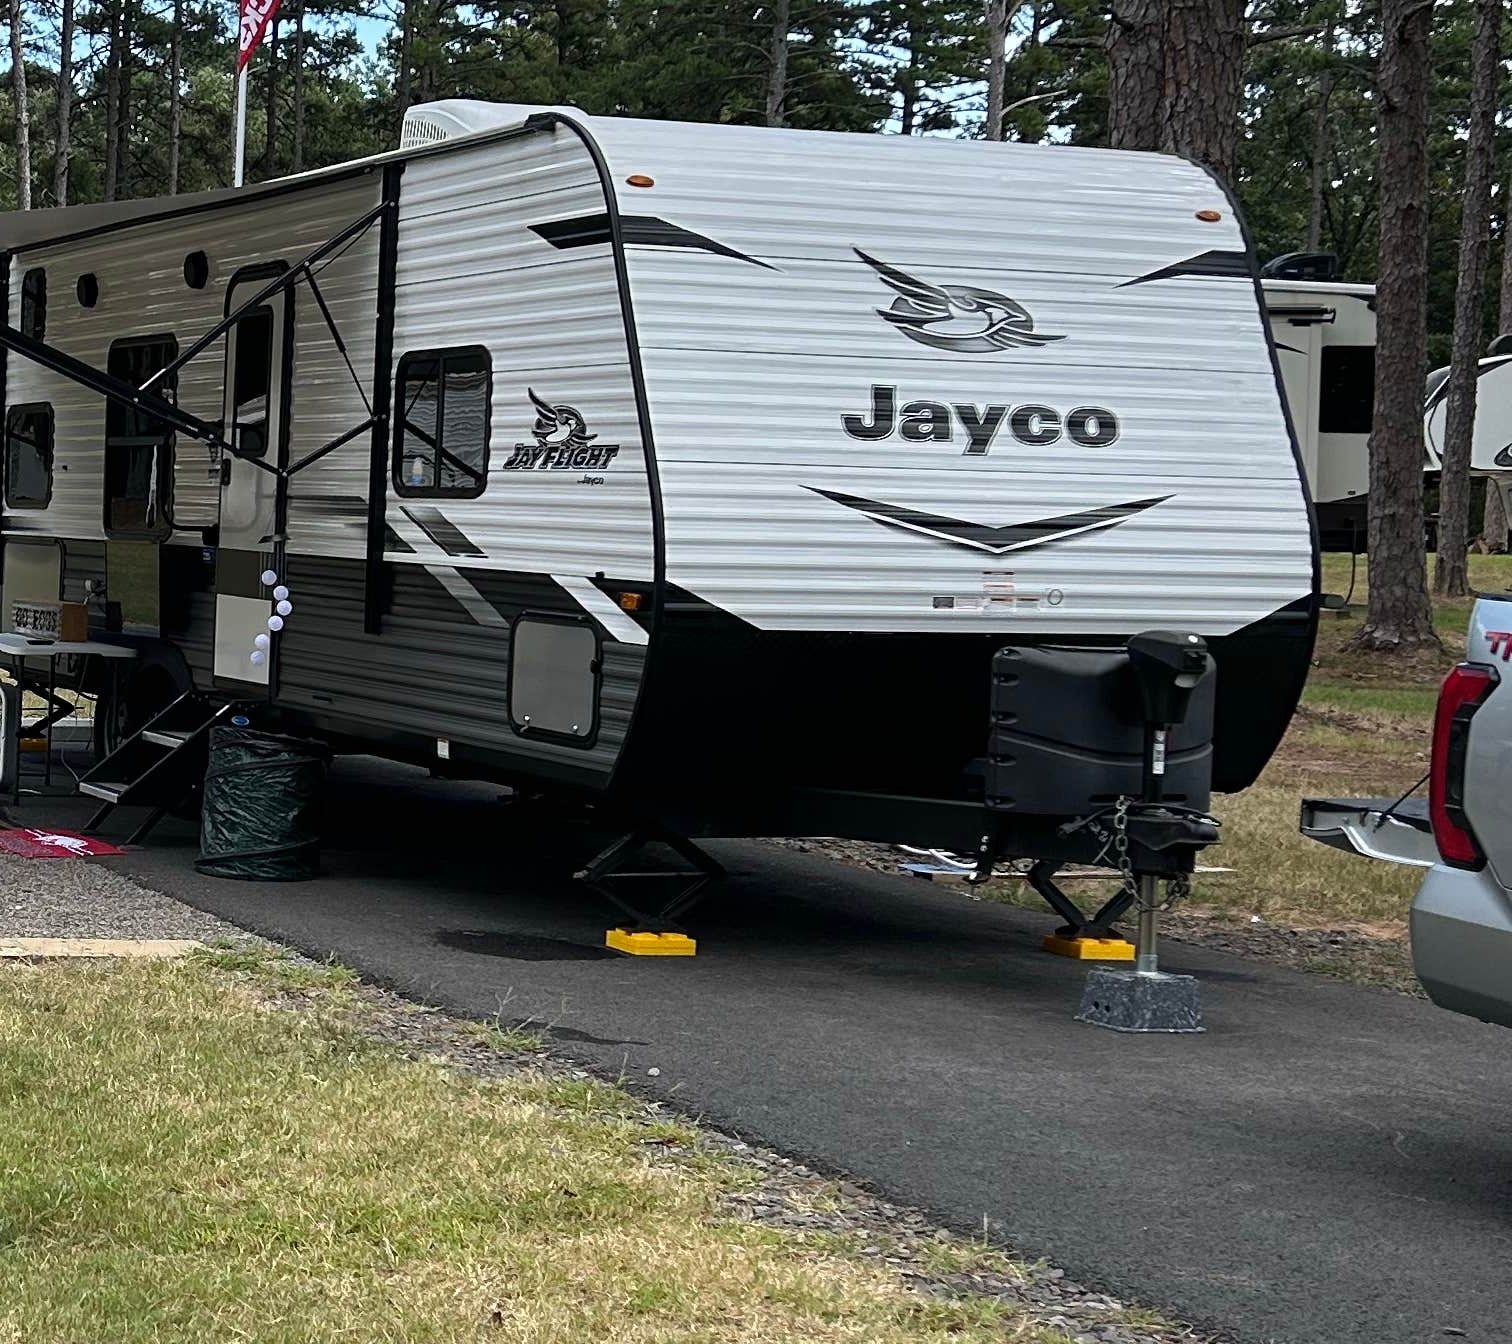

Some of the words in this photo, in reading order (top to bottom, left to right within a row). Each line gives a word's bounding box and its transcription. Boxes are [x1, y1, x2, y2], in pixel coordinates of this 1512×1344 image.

[840, 384, 1122, 456] Jayco
[503, 443, 549, 469] JAY
[538, 444, 620, 469] FLIGHT
